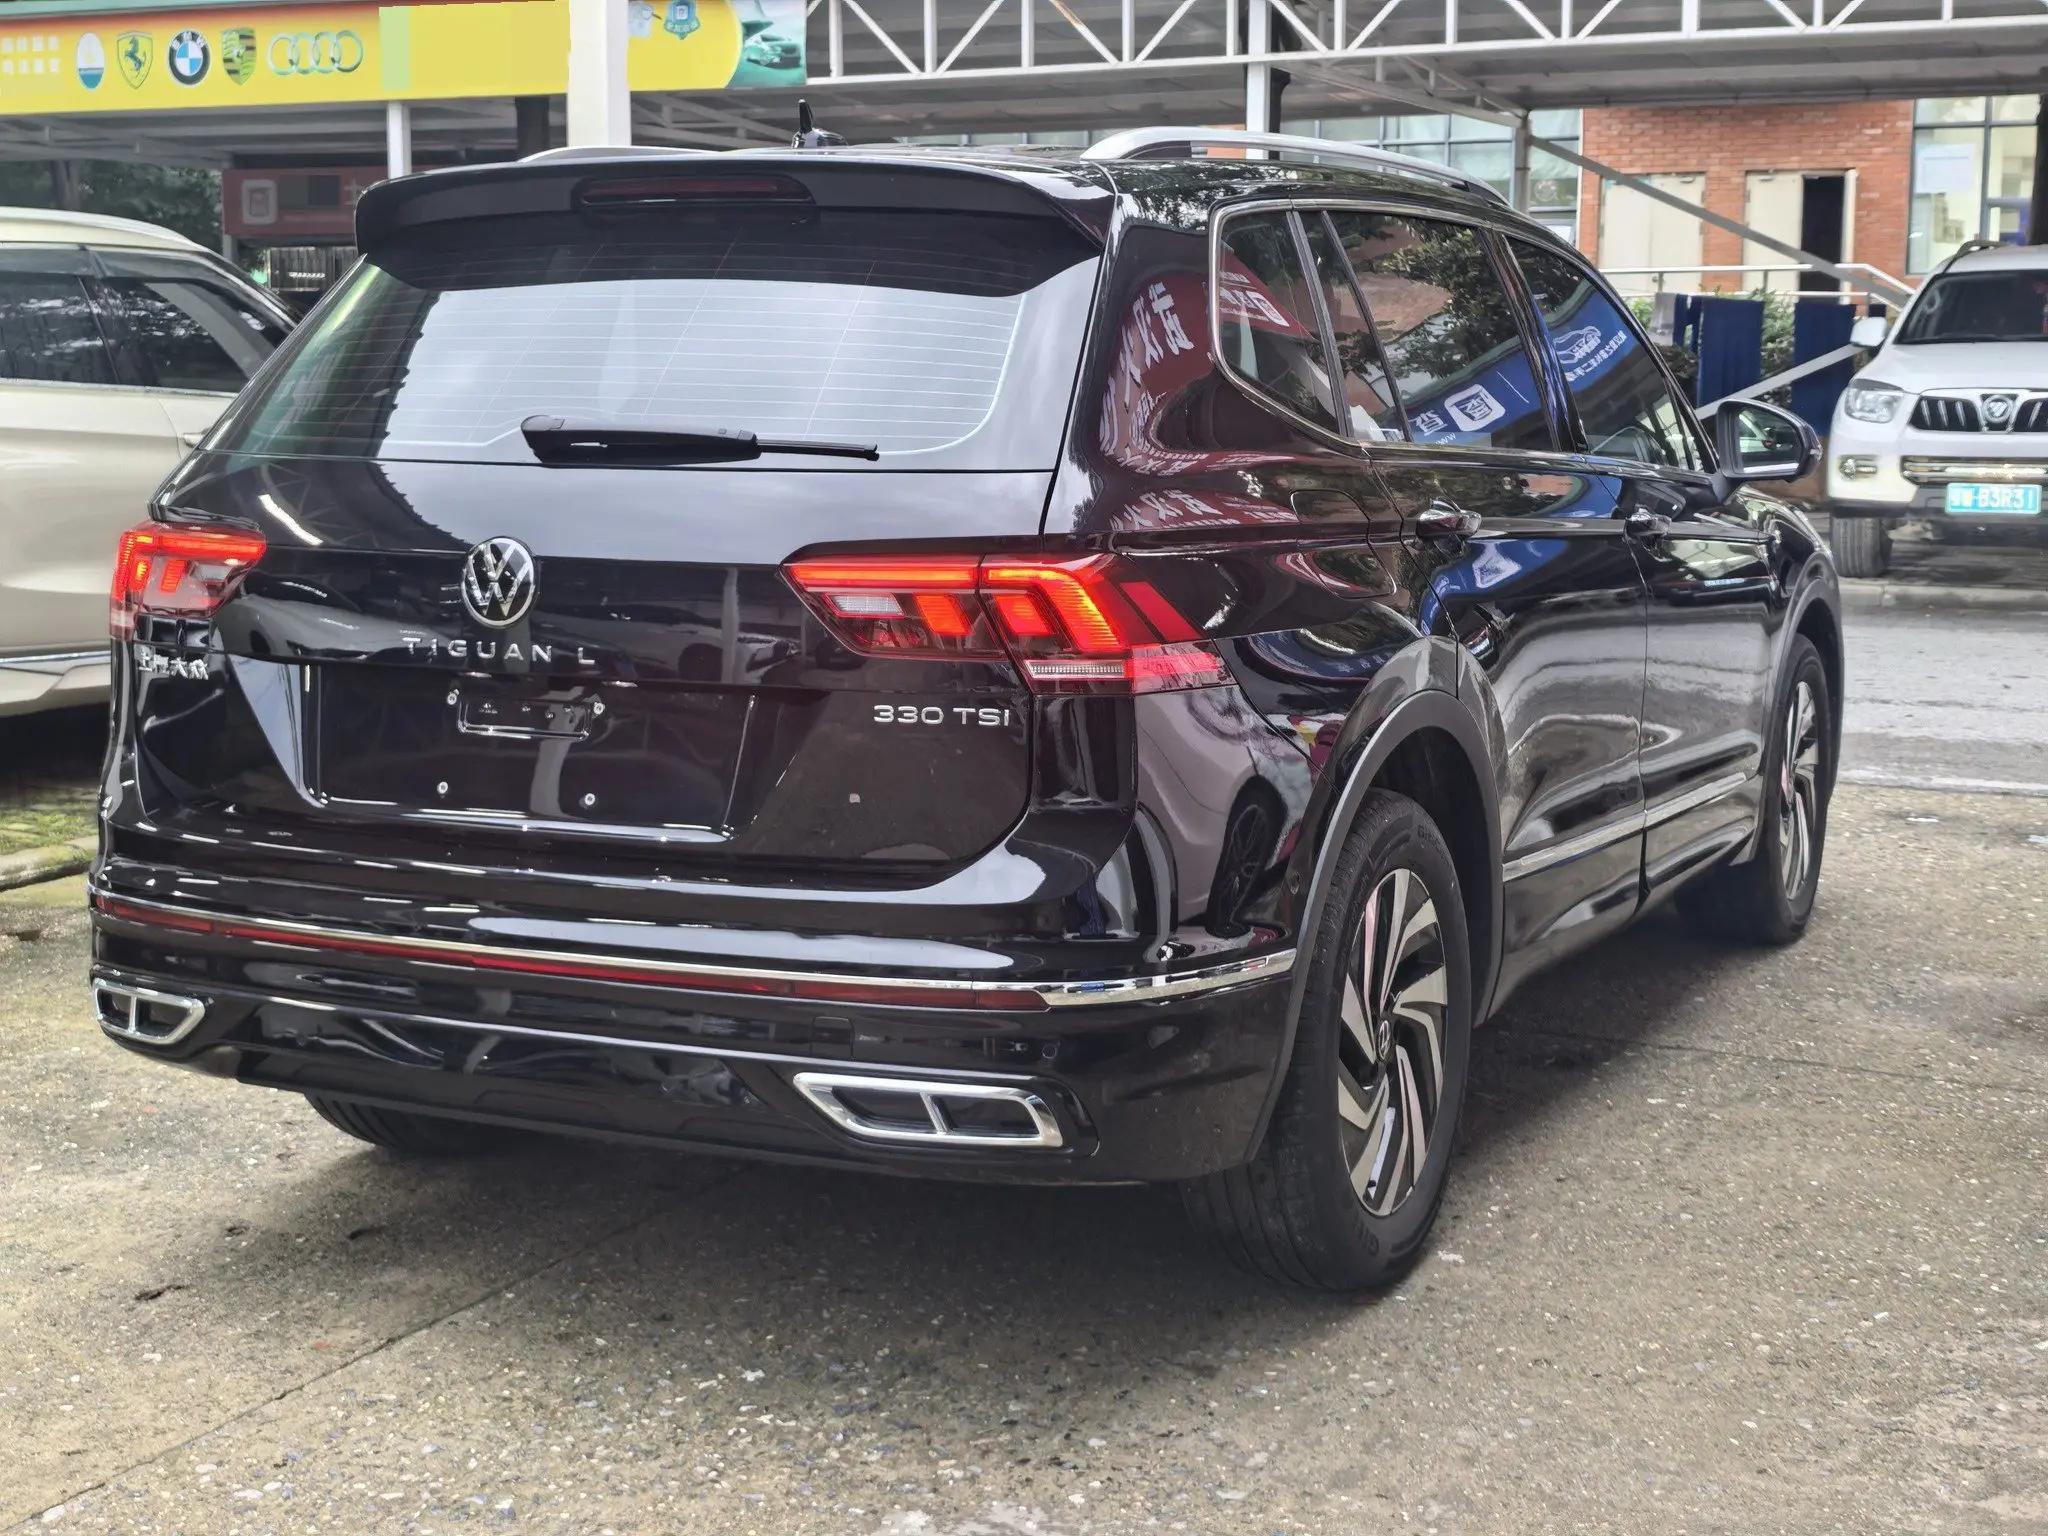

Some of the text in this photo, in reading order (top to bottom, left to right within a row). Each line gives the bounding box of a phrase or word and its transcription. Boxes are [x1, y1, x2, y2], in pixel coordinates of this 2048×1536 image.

[402, 637, 595, 665] TIGUAN L
[873, 704, 1010, 727] 330 TSI
